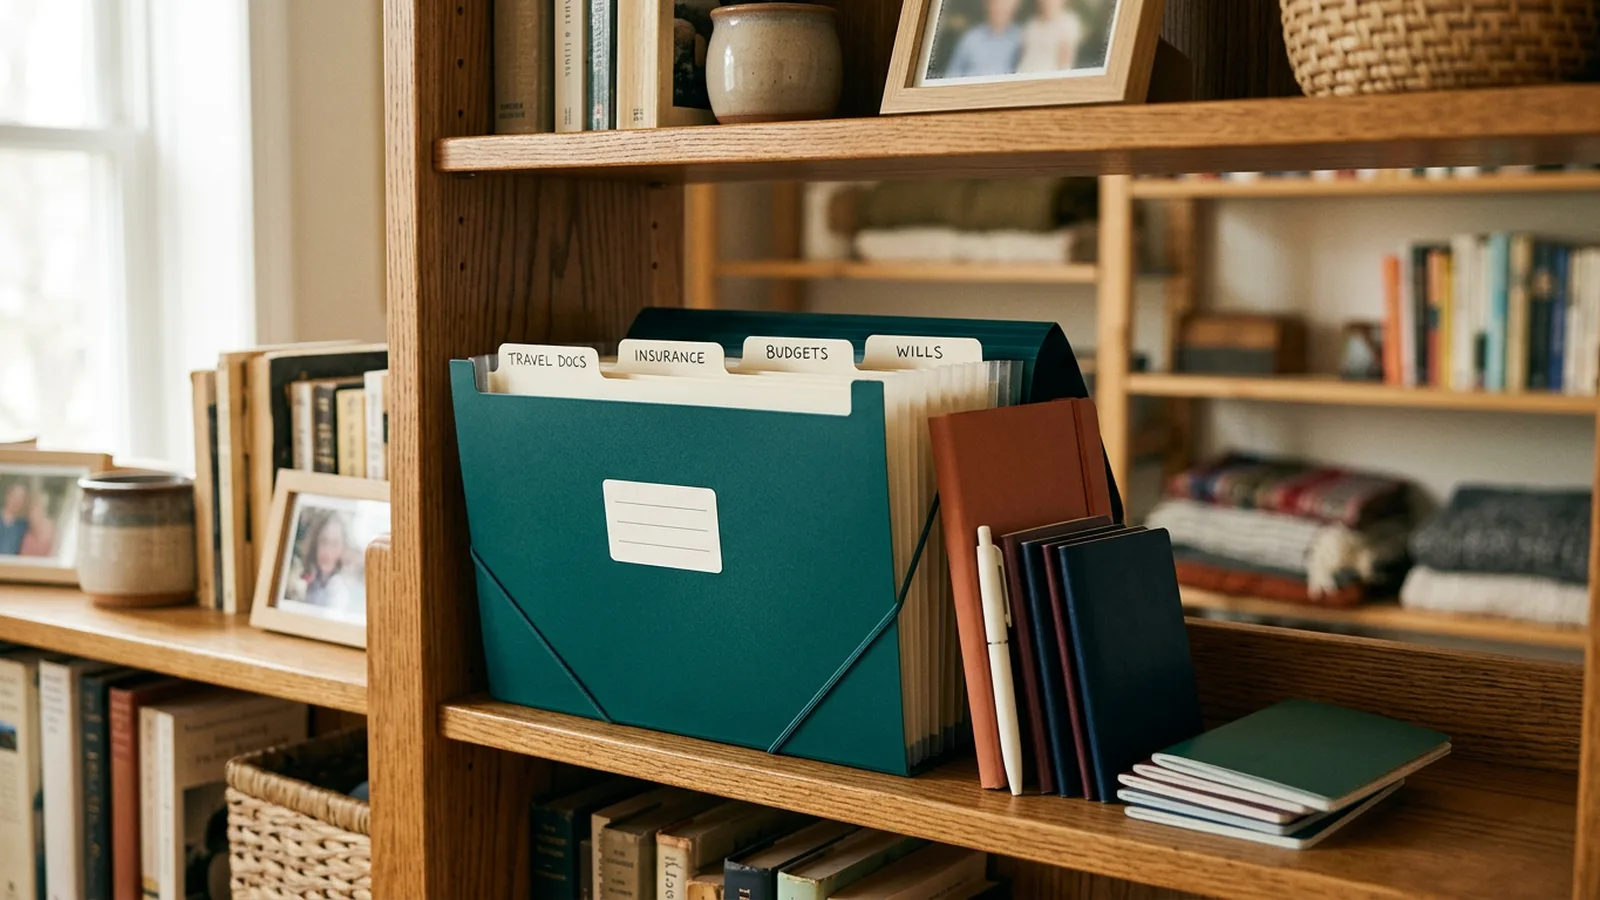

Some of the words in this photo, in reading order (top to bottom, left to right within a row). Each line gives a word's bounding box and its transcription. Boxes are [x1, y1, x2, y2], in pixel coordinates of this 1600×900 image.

[634, 349, 706, 365] INSURANCE
[765, 344, 829, 360] BUDGETS
[896, 345, 944, 360] WILLS
[507, 352, 553, 367] TRAVEL
[557, 354, 587, 369] DOCS
